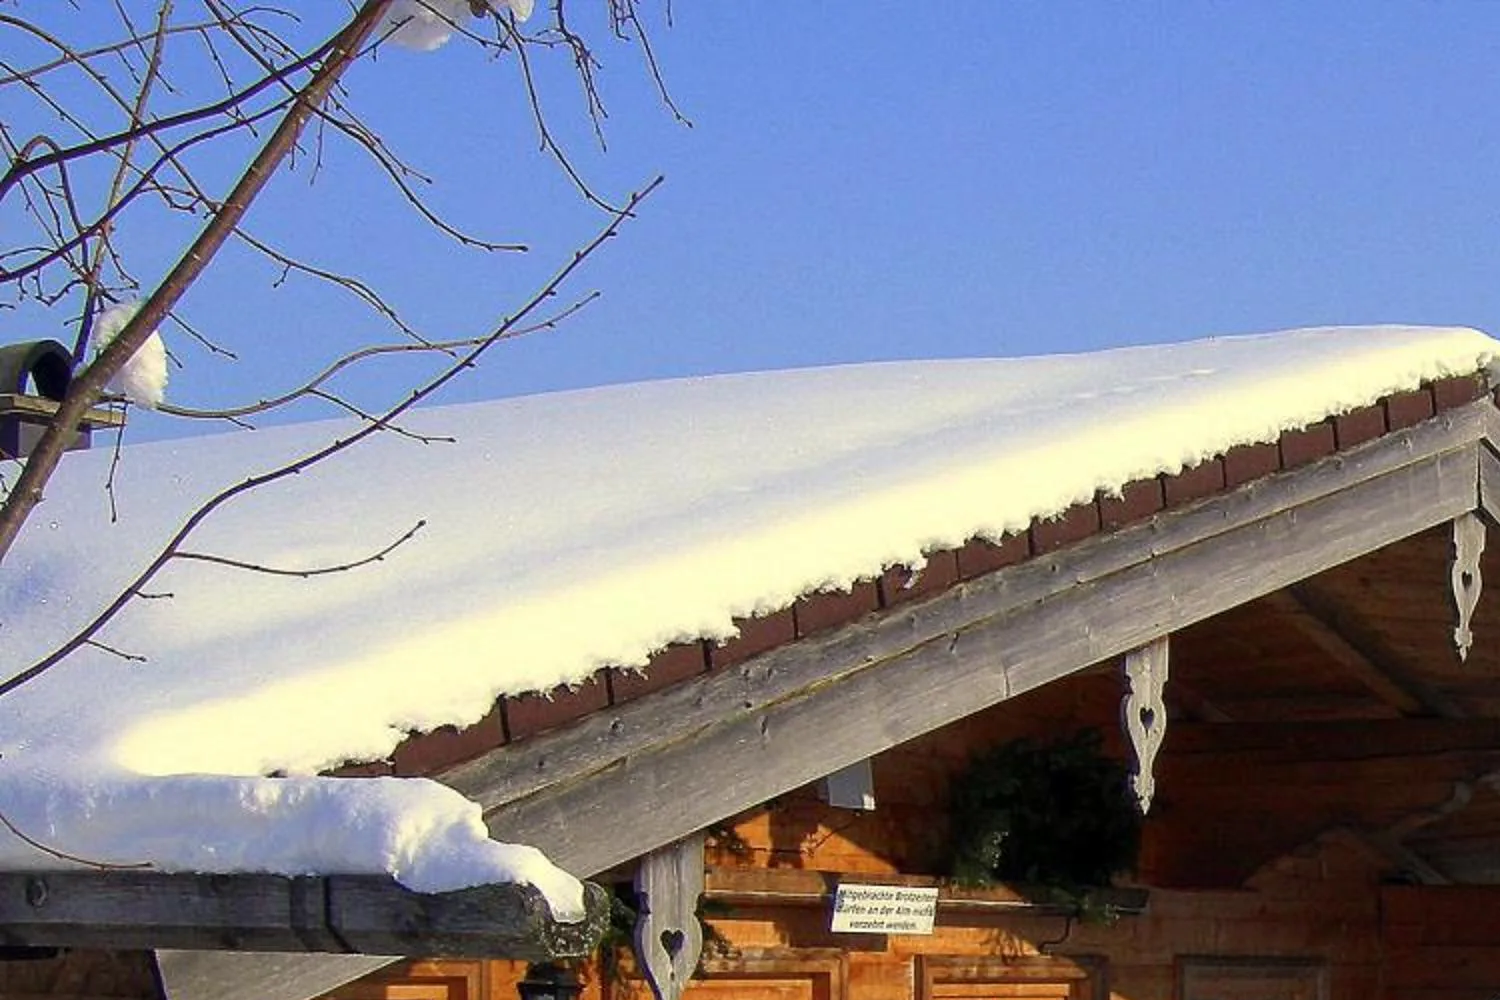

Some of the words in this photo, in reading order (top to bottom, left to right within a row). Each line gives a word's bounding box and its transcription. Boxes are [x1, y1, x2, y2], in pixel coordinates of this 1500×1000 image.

[867, 906, 879, 915] an
[880, 905, 894, 915] der
[896, 906, 911, 915] Alm
[849, 919, 885, 929] verzehrt
